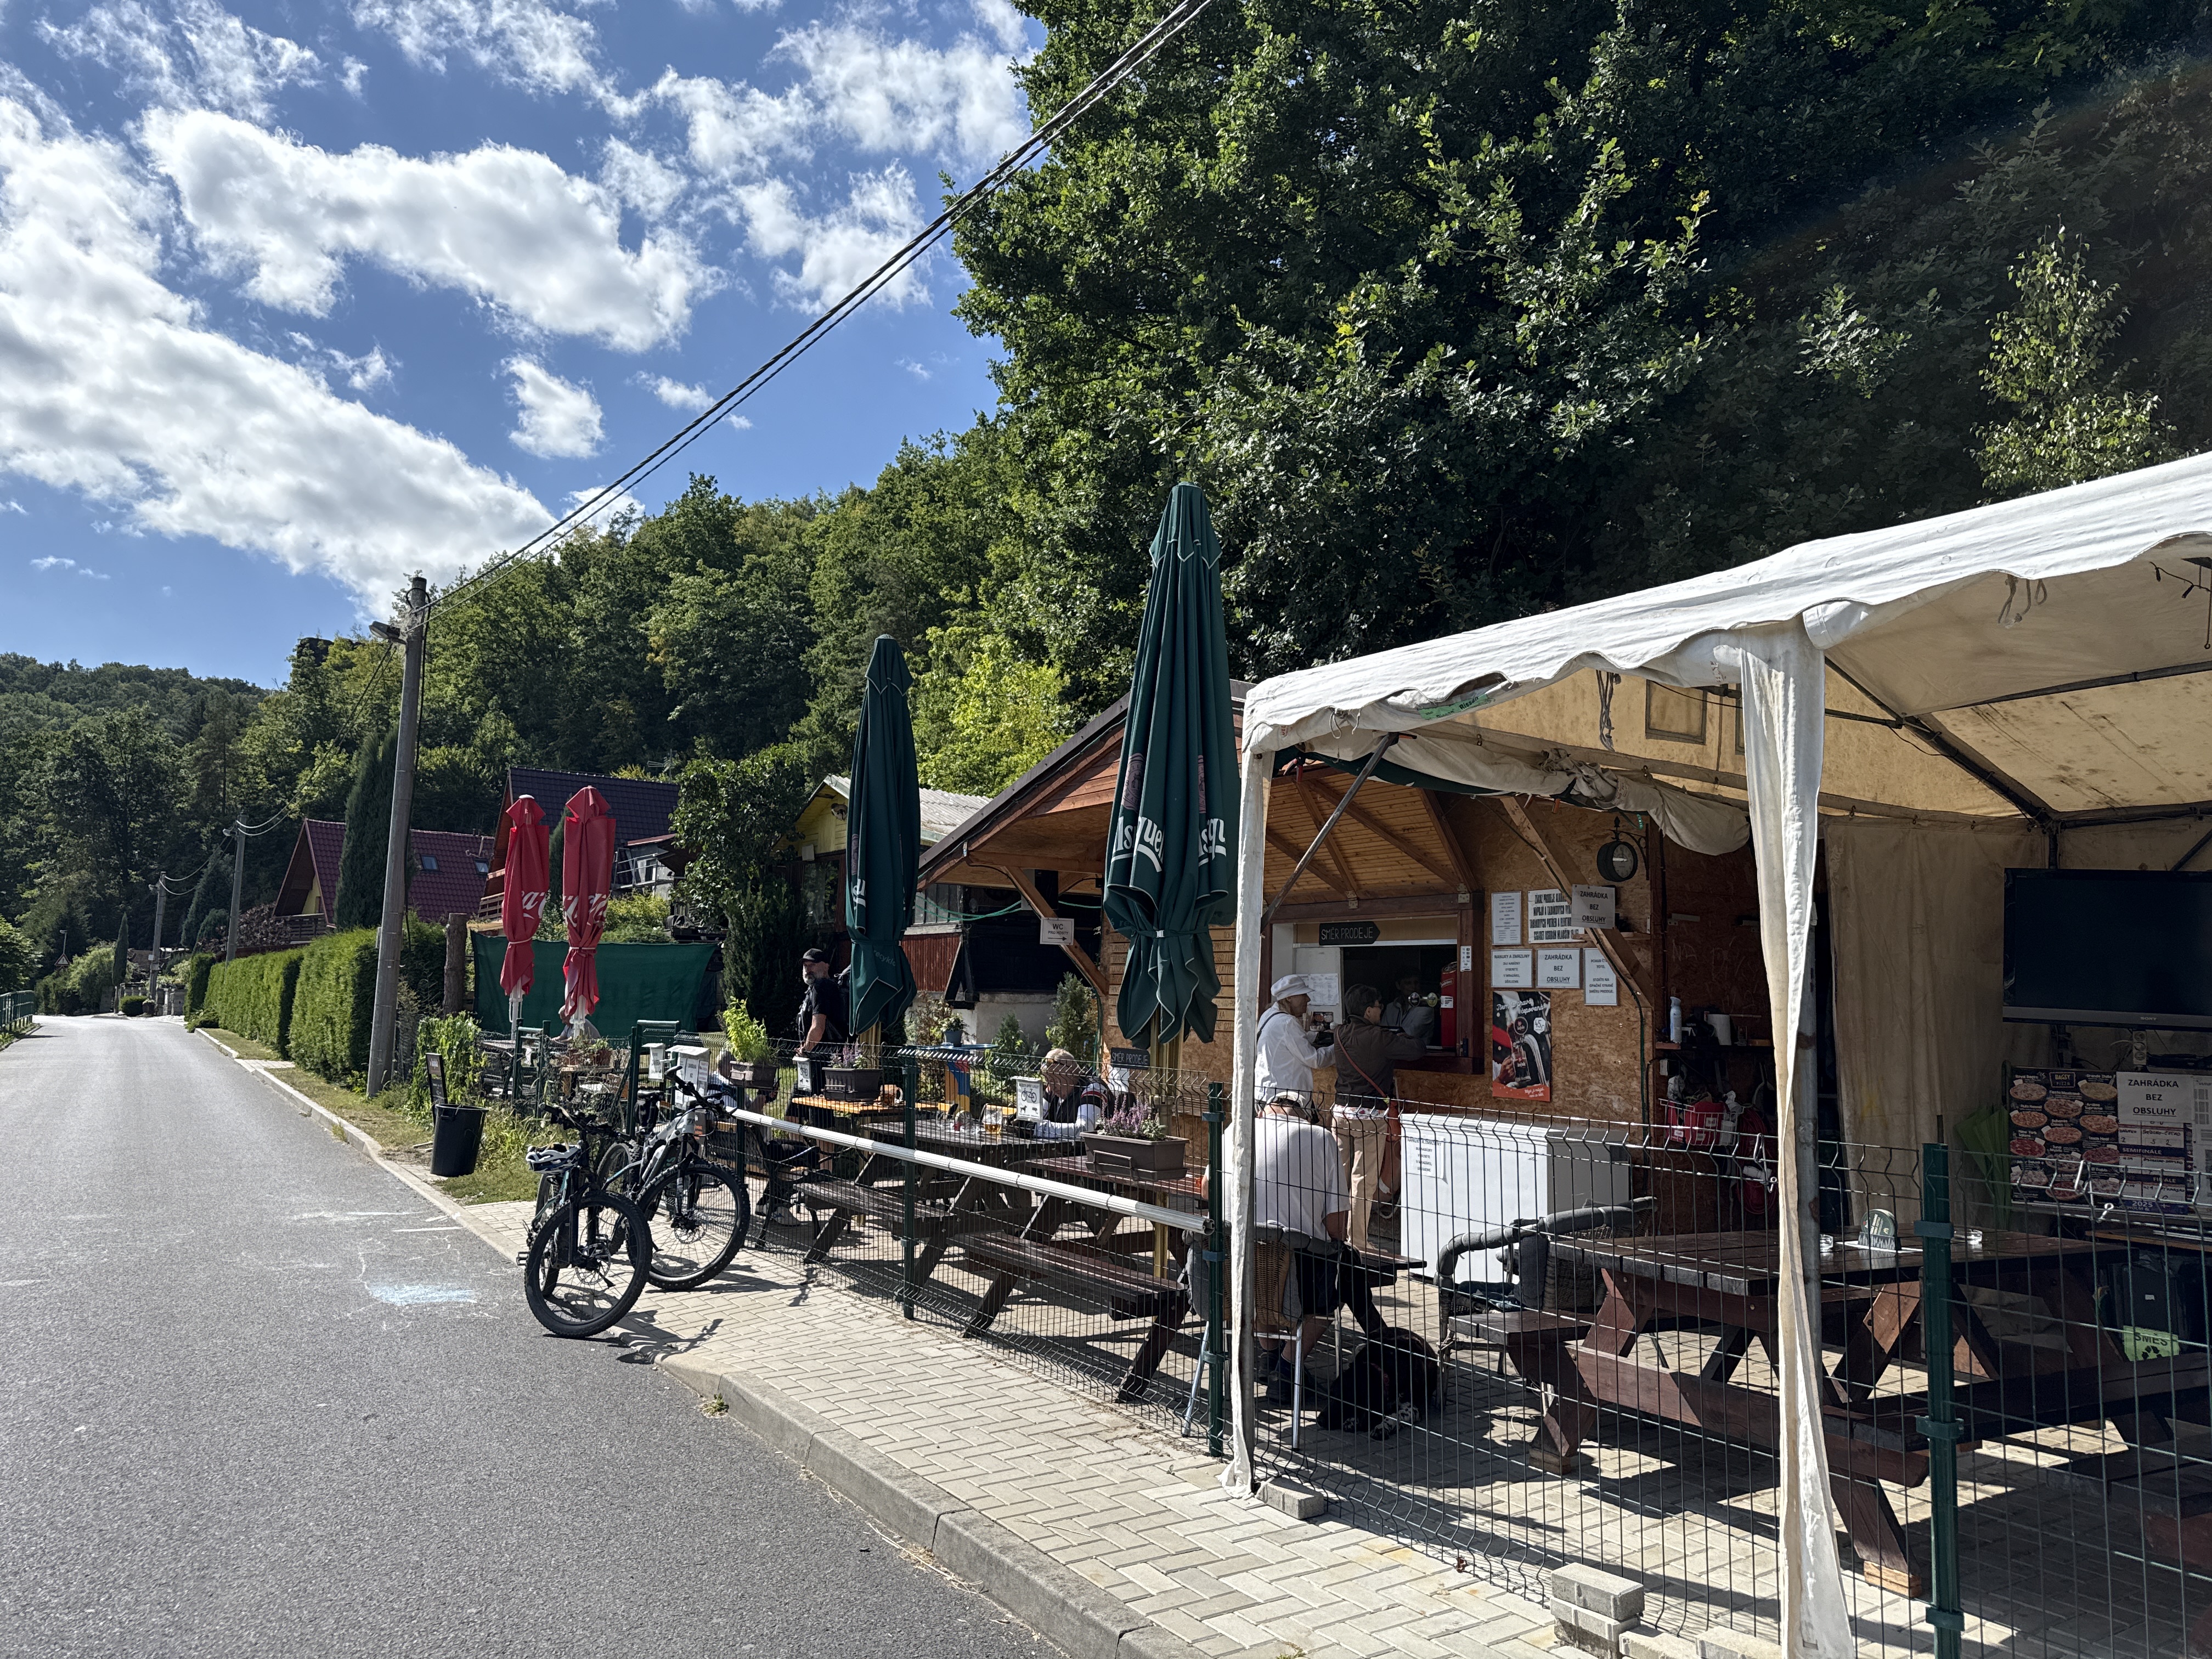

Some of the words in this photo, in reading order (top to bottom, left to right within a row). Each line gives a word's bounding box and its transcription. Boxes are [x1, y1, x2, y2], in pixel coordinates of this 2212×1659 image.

[1580, 890, 1609, 899] ZAHRÁDKA
[1321, 927, 1339, 940] SMĚR
[1341, 927, 1373, 939] PRODEJE
[1111, 1051, 1125, 1063] SMĚR
[1126, 1053, 1148, 1065] PRODEJE
[2128, 1079, 2179, 1088] ZAHRÁDKA
[2133, 1107, 2176, 1115] OBSLUHY
